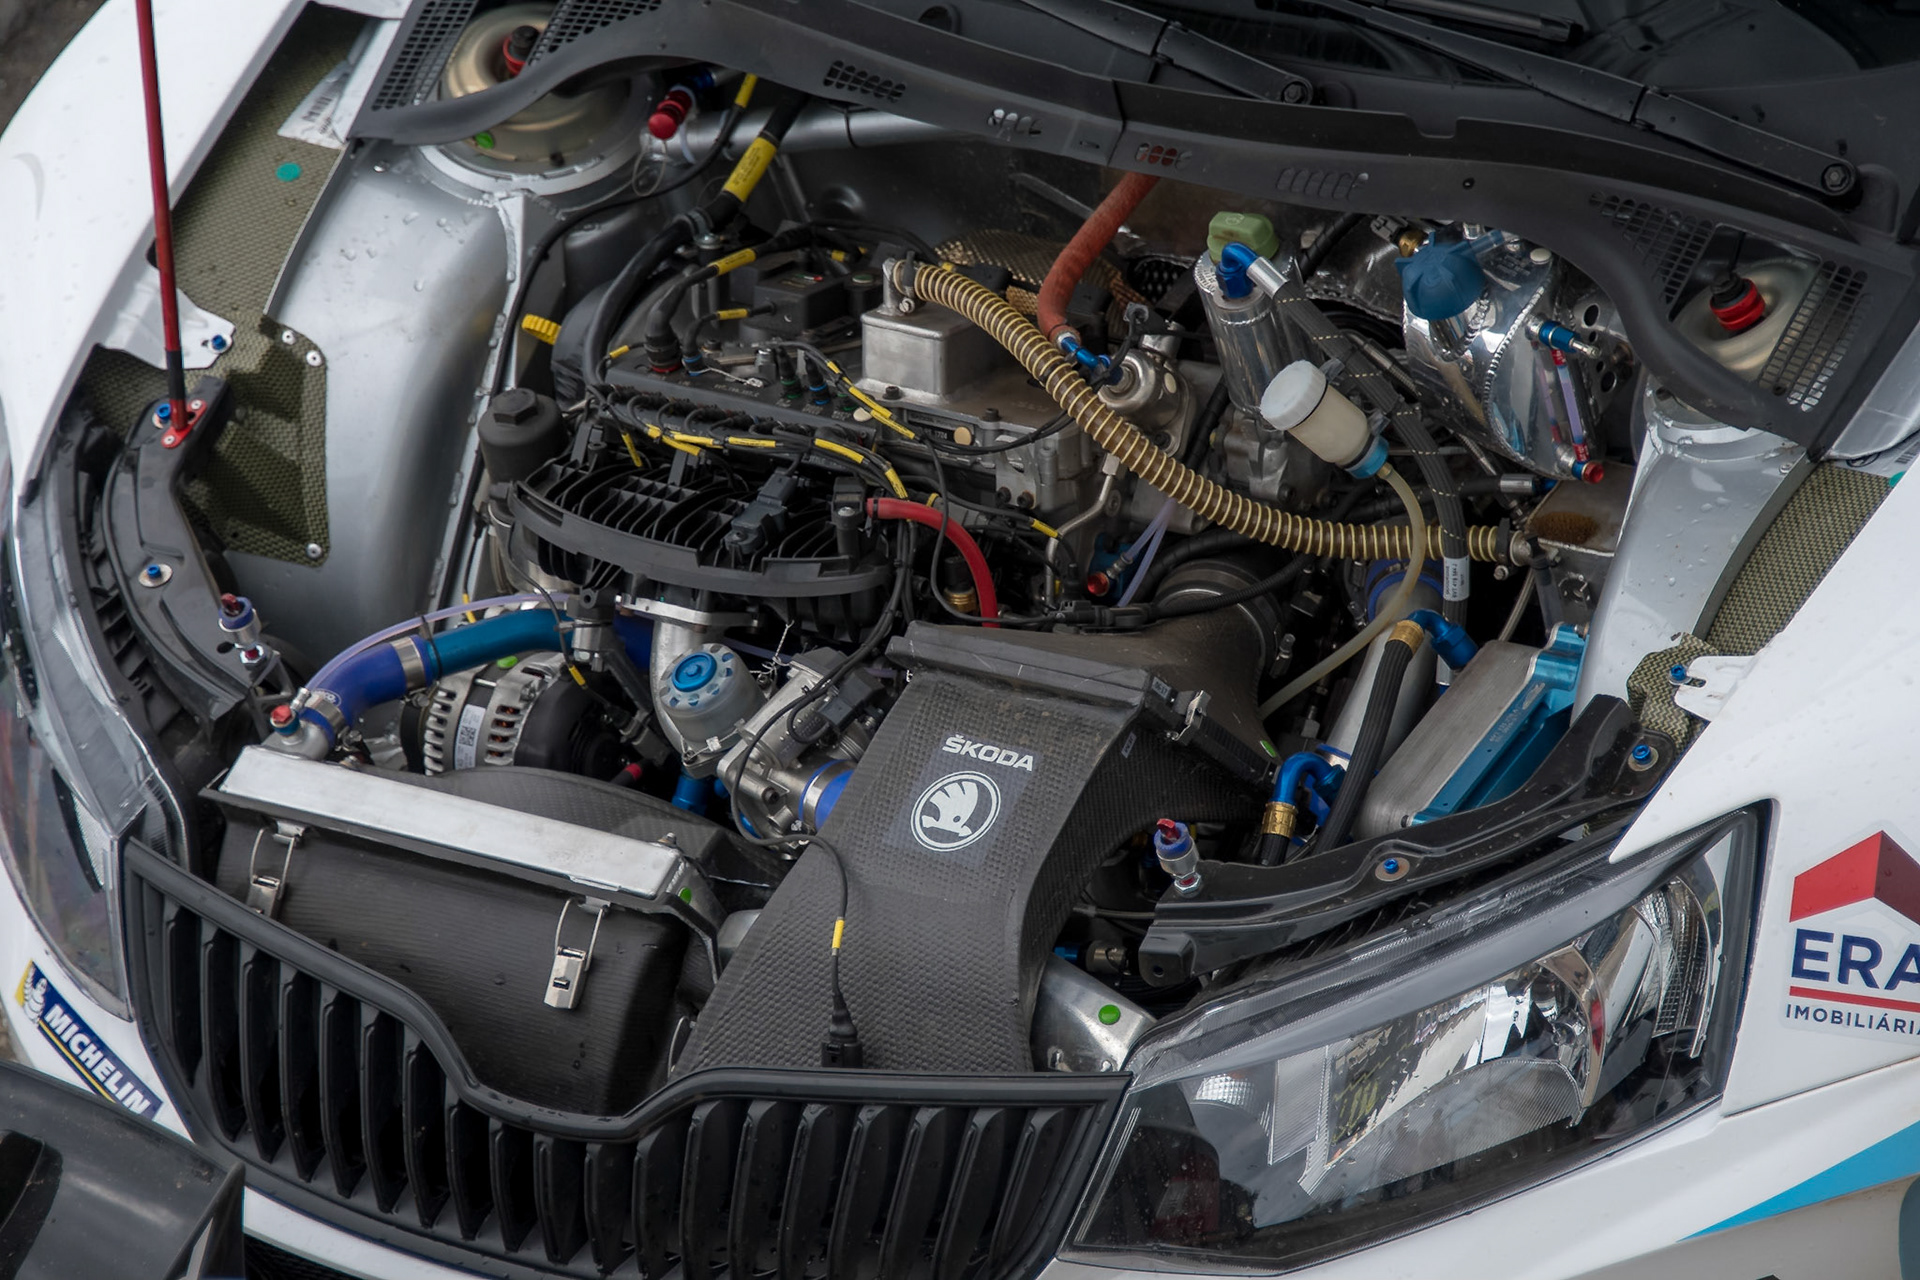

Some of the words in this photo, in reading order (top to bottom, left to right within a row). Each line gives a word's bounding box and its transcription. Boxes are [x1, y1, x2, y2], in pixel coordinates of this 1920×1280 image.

[942, 734, 1034, 772] ŠKODA
[1791, 928, 1920, 990] ERA
[1785, 1003, 1920, 1036] IMOBILIÁRI
[44, 1003, 151, 1114] MICHELIN
